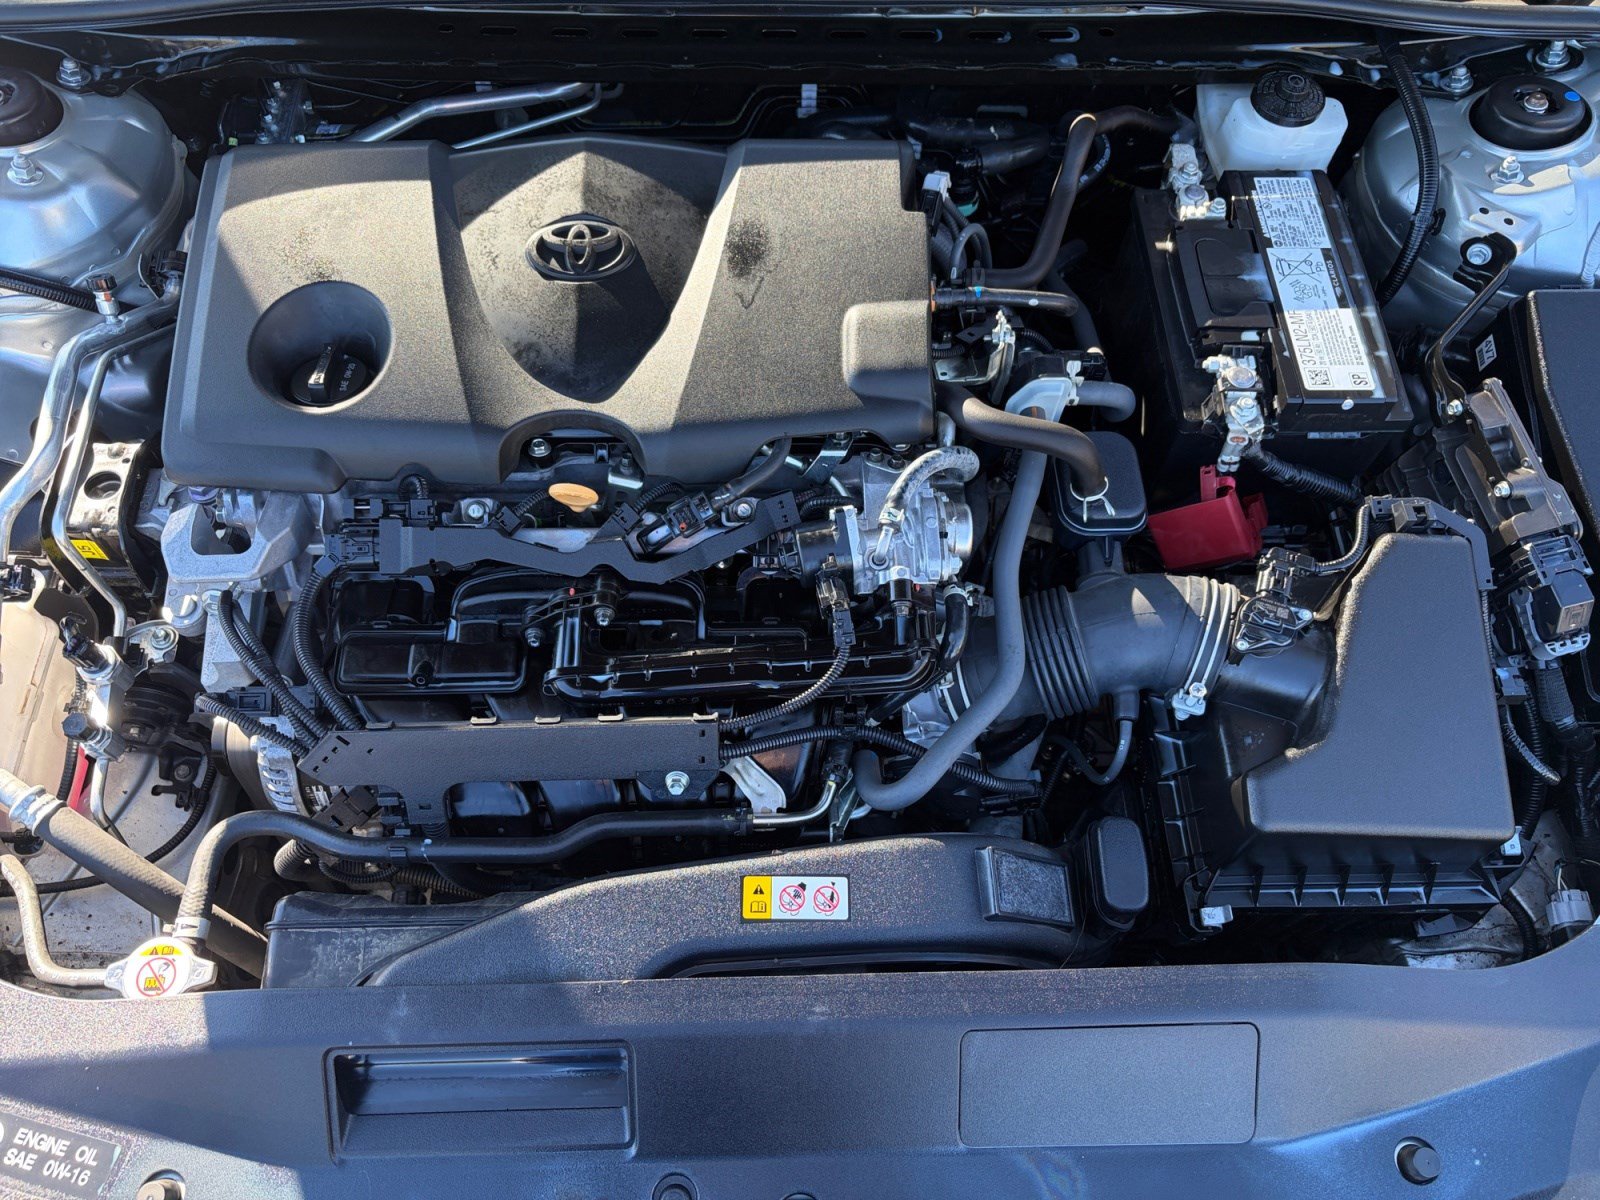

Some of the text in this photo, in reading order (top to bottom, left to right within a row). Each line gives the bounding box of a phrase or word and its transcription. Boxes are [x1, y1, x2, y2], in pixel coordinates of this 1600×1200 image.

[1326, 260, 1340, 286] CLARIOS
[1288, 310, 1317, 366] 375LN2-MF
[1352, 373, 1368, 386] SP
[13, 1127, 98, 1167] ENGINE OIL
[3, 1148, 91, 1187] SAE 0W-16
